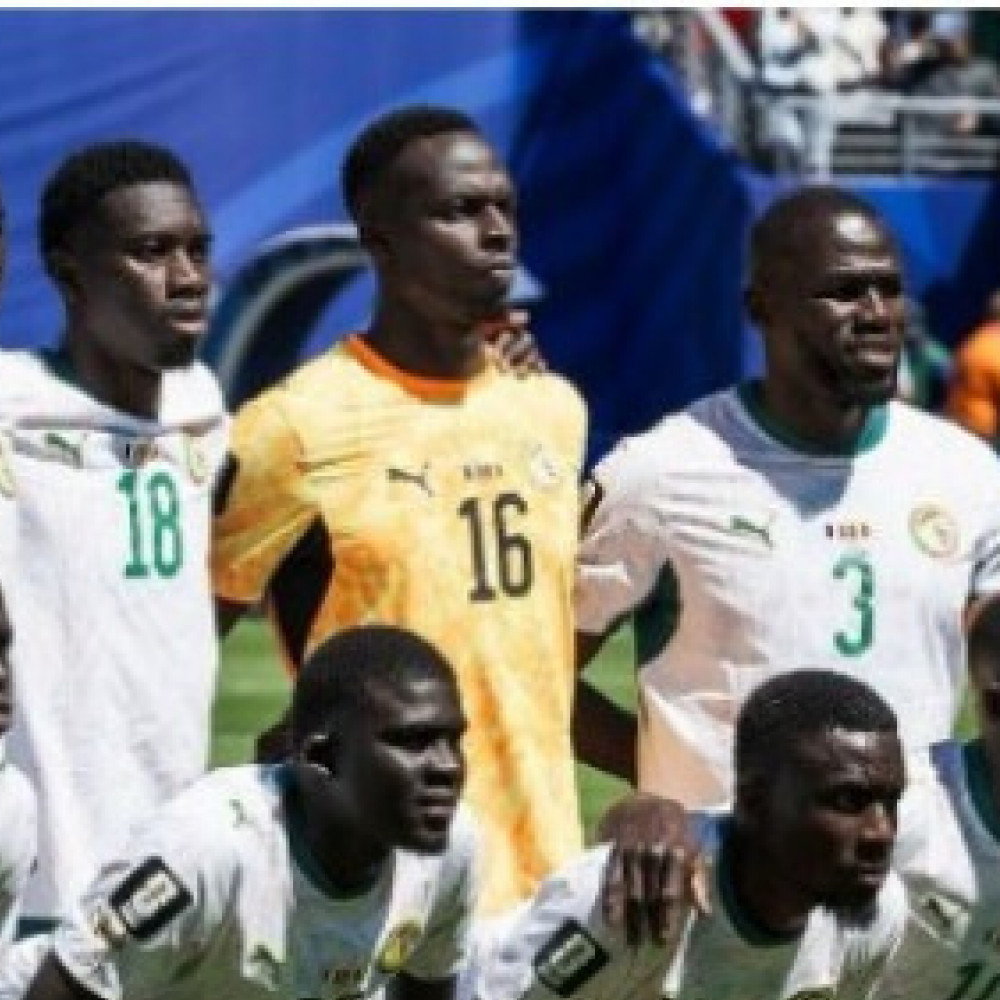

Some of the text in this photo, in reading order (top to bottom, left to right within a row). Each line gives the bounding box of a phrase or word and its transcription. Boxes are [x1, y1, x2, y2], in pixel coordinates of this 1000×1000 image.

[117, 472, 183, 579] 18
[457, 491, 534, 603] 16
[833, 553, 875, 657] 3
